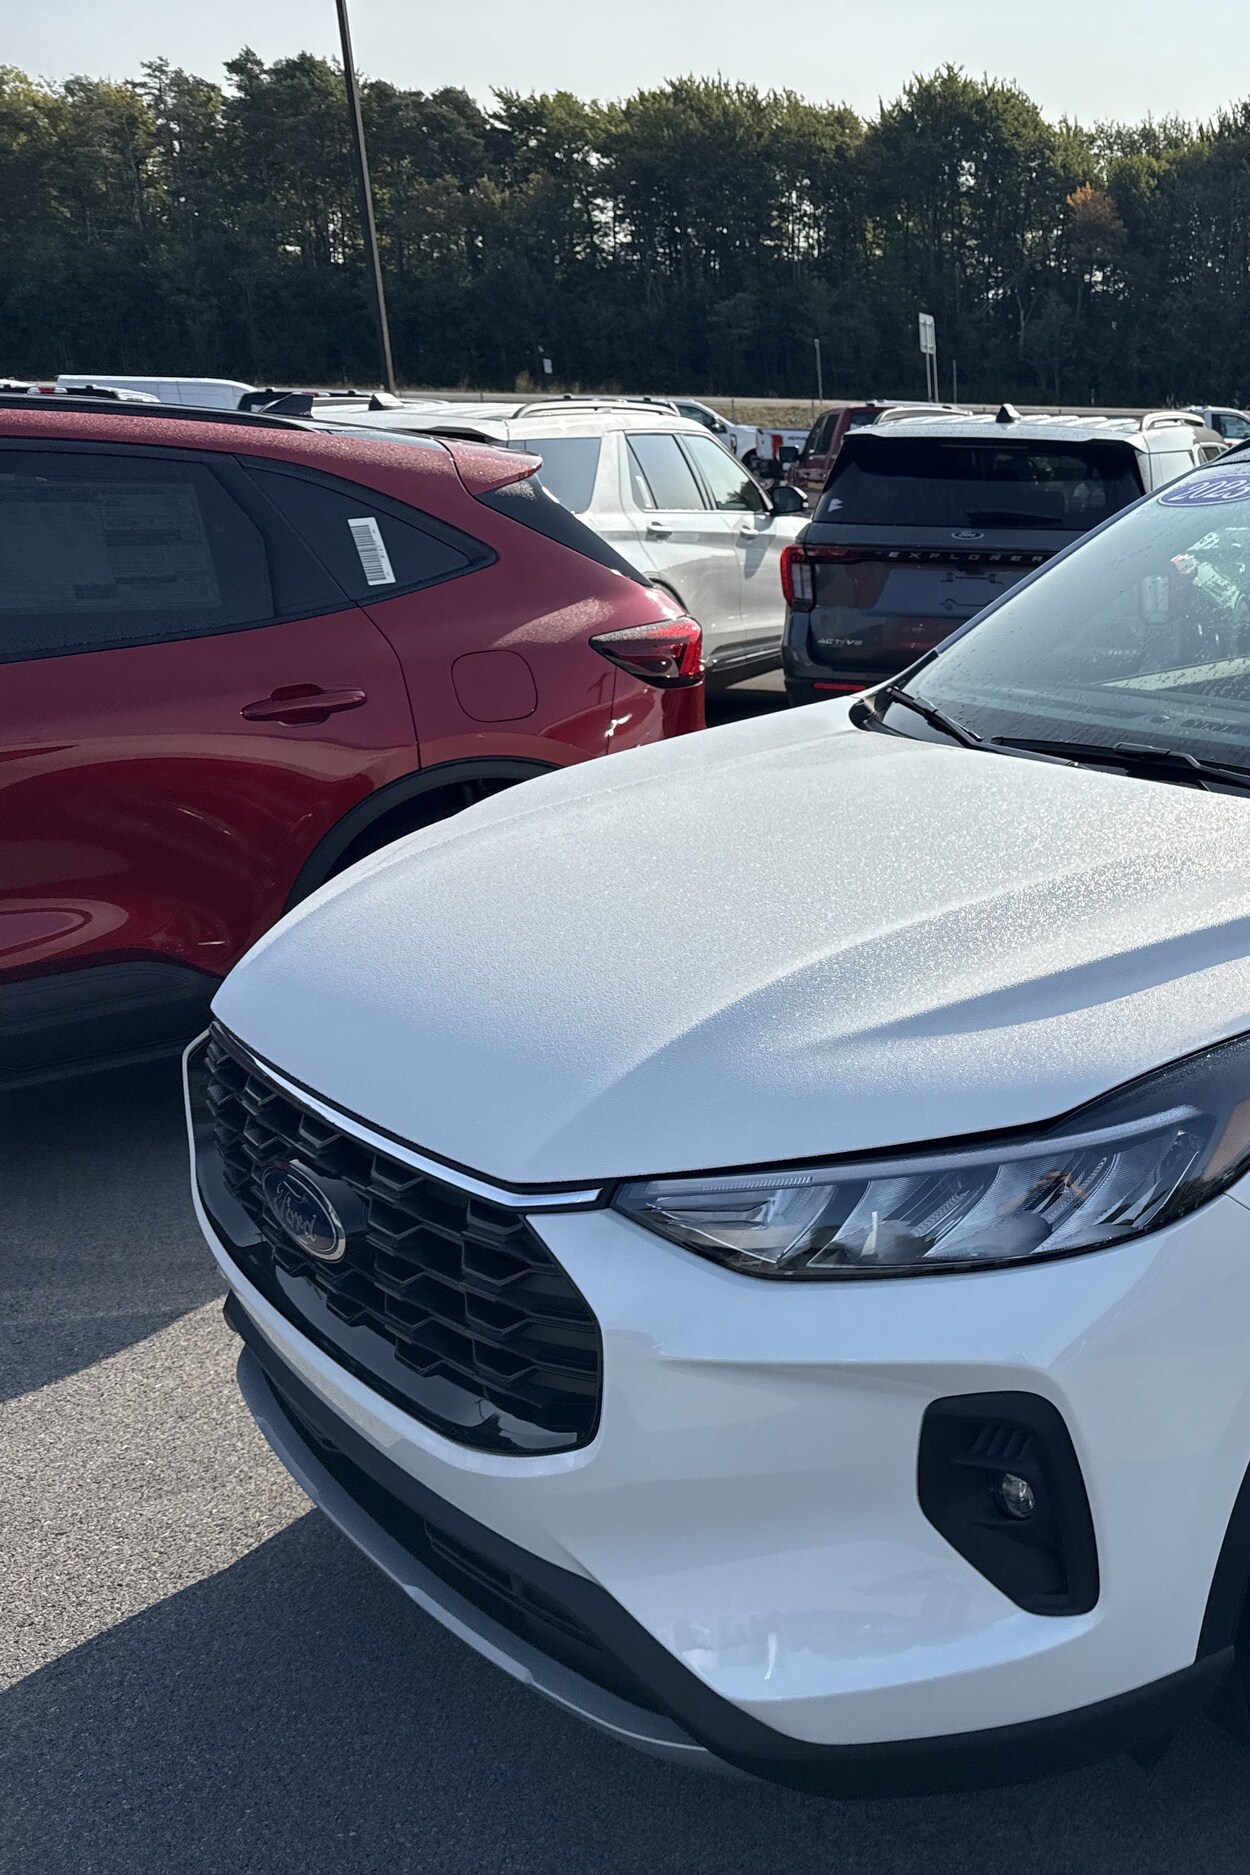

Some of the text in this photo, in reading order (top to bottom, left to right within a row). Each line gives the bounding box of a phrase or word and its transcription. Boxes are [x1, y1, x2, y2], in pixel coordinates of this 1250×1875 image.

[888, 551, 1044, 562] EXPLORER
[817, 637, 864, 646] ACTIVE
[273, 1180, 318, 1242] Ford
